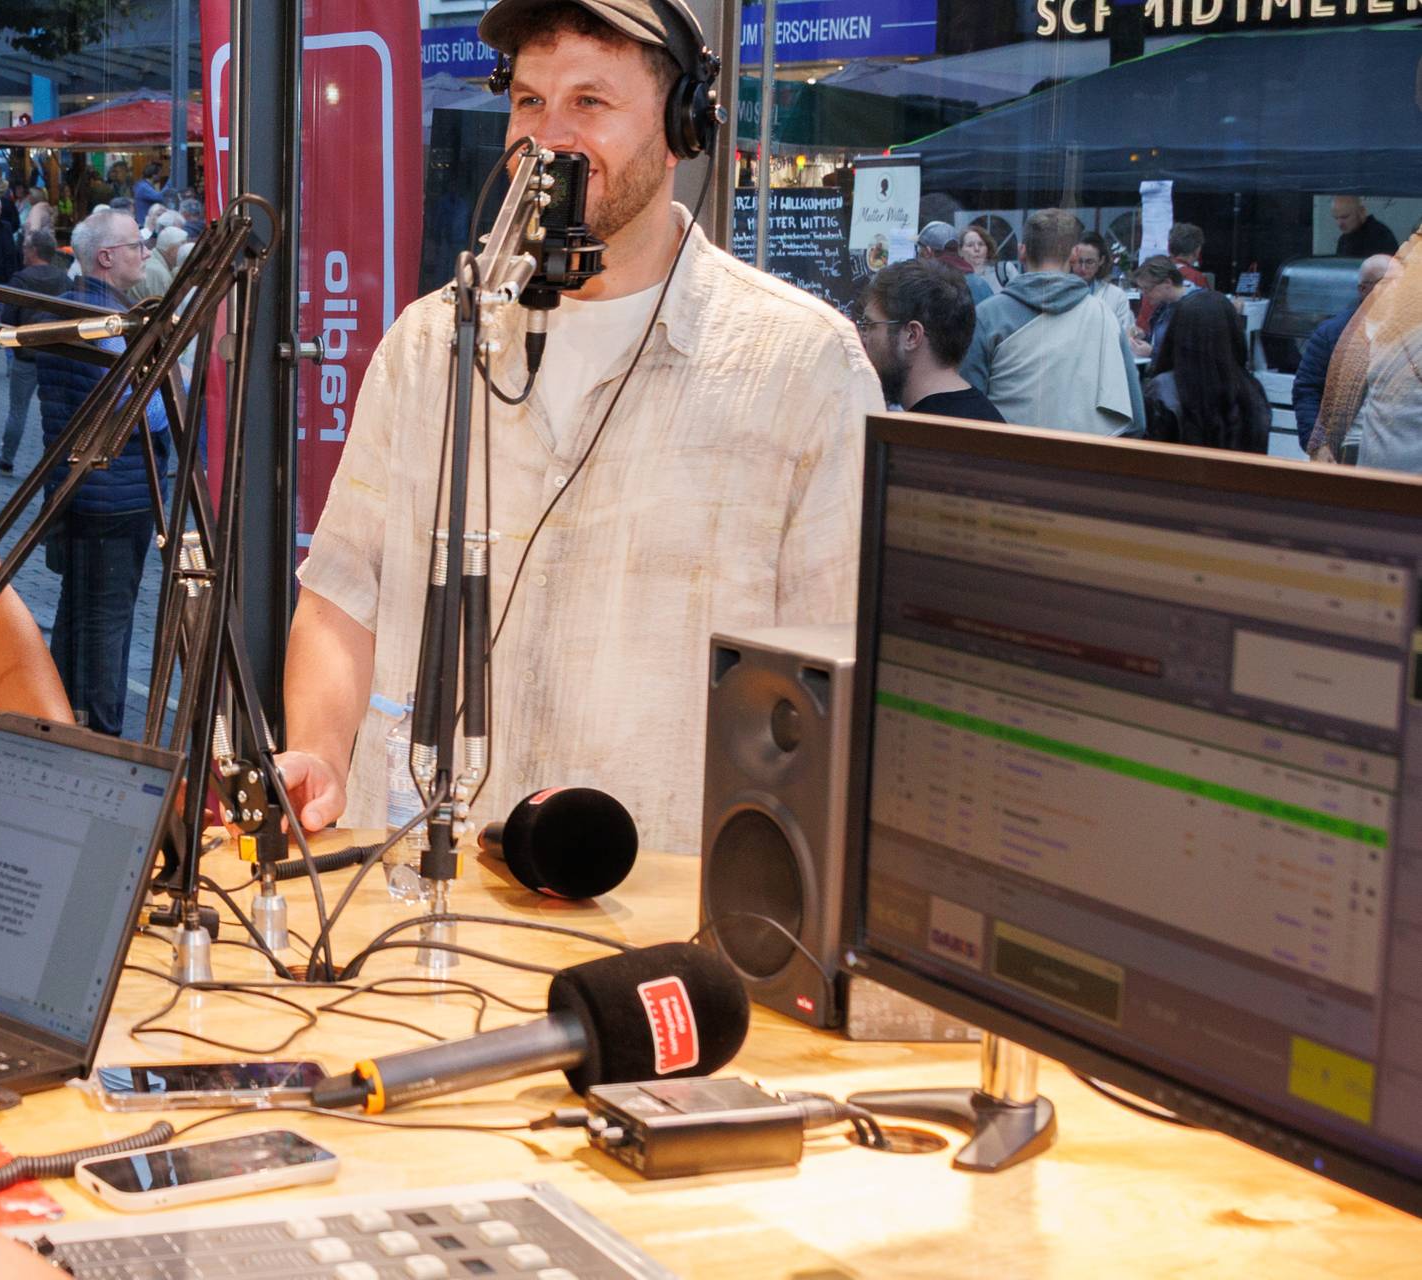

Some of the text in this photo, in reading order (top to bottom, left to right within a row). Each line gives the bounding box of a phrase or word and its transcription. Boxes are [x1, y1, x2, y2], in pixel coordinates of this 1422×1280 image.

[761, 16, 871, 45] ERSCHENKEN
[452, 38, 474, 62] FÜR
[780, 196, 843, 211] WILLKOMMEN
[800, 216, 839, 229] WITTIG
[320, 250, 358, 442] radio
